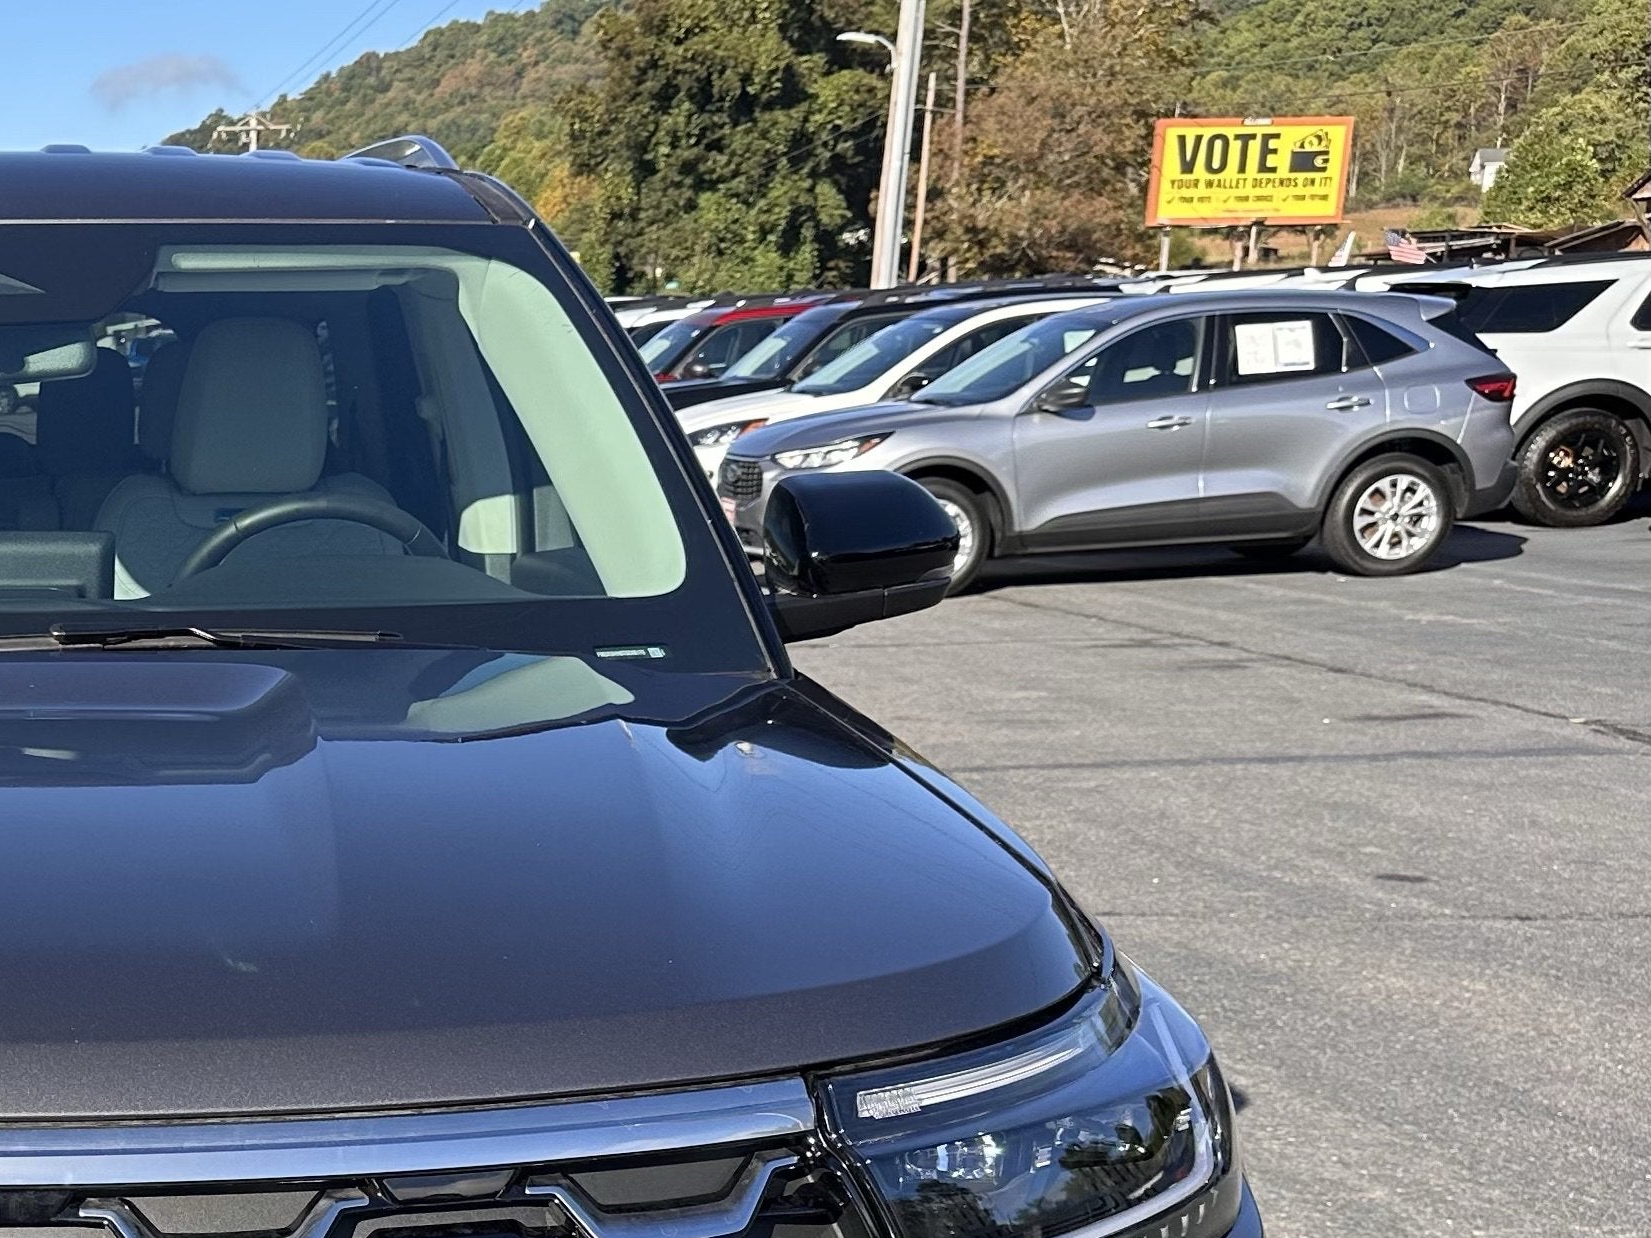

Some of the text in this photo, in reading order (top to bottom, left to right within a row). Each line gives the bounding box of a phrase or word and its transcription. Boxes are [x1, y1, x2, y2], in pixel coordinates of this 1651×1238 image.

[1177, 133, 1281, 175] VOTE
[1170, 179, 1200, 190] YOUR
[1205, 178, 1248, 189] WALLET
[1252, 177, 1298, 188] DEPENDS
[1302, 177, 1316, 188] ON
